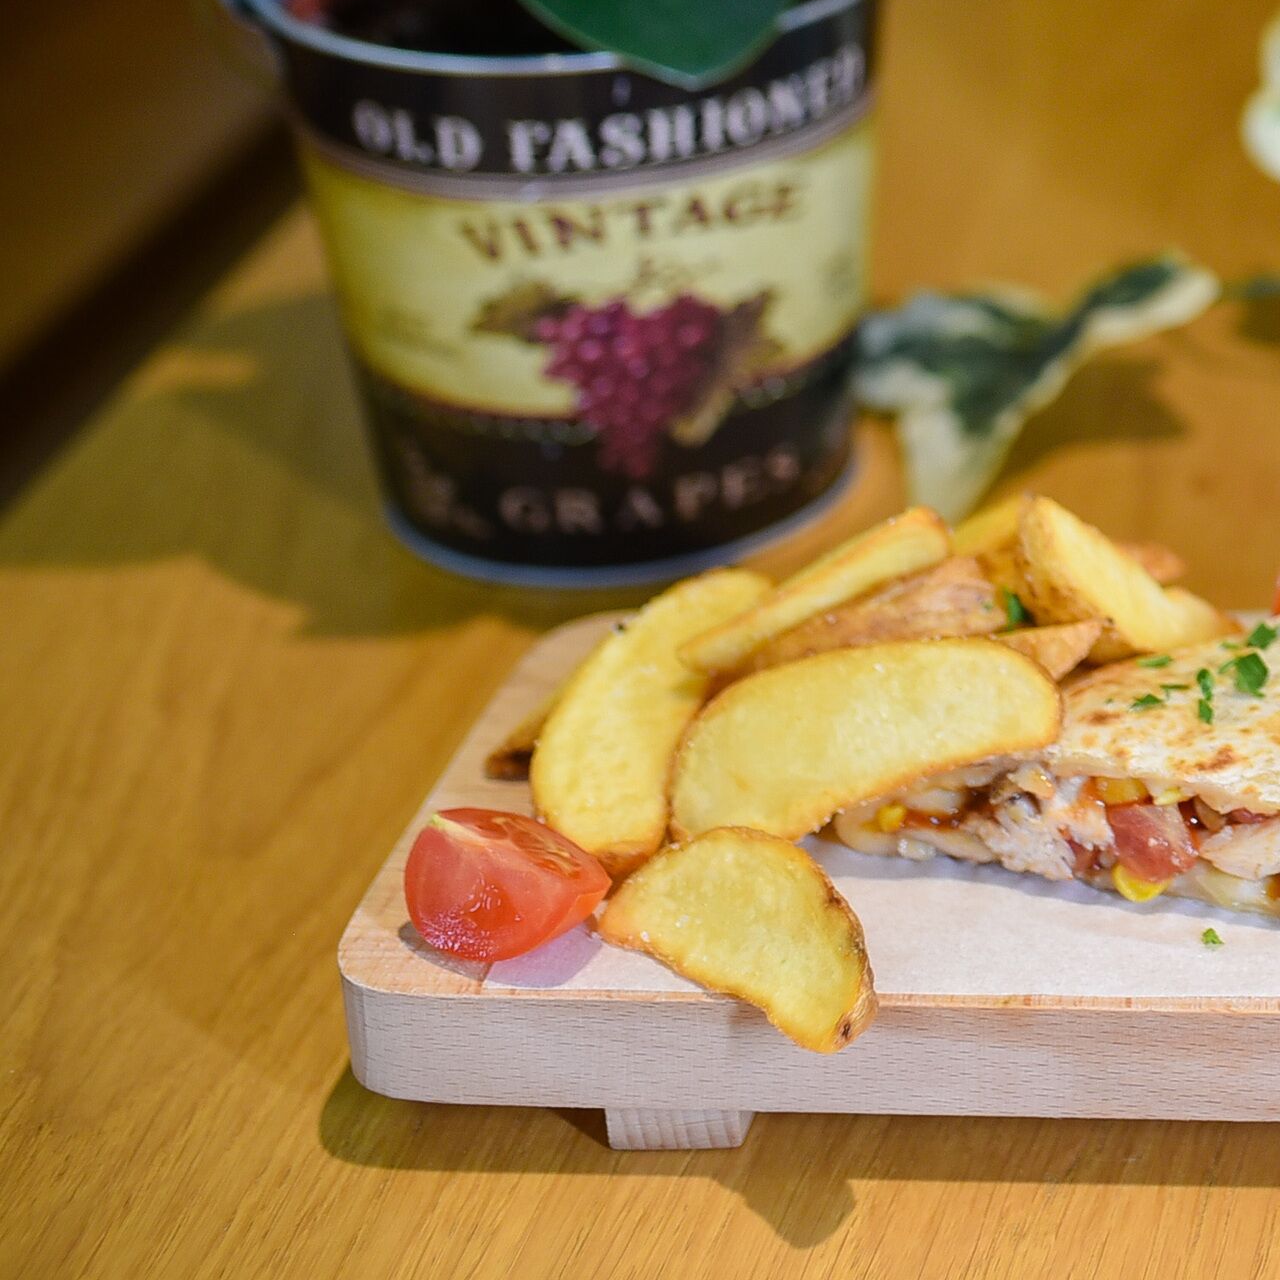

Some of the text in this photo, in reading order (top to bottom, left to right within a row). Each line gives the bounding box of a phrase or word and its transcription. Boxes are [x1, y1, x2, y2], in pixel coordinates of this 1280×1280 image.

[354, 98, 483, 173] OLD
[458, 182, 798, 263] VINTAGE
[498, 440, 802, 535] GRAPES
